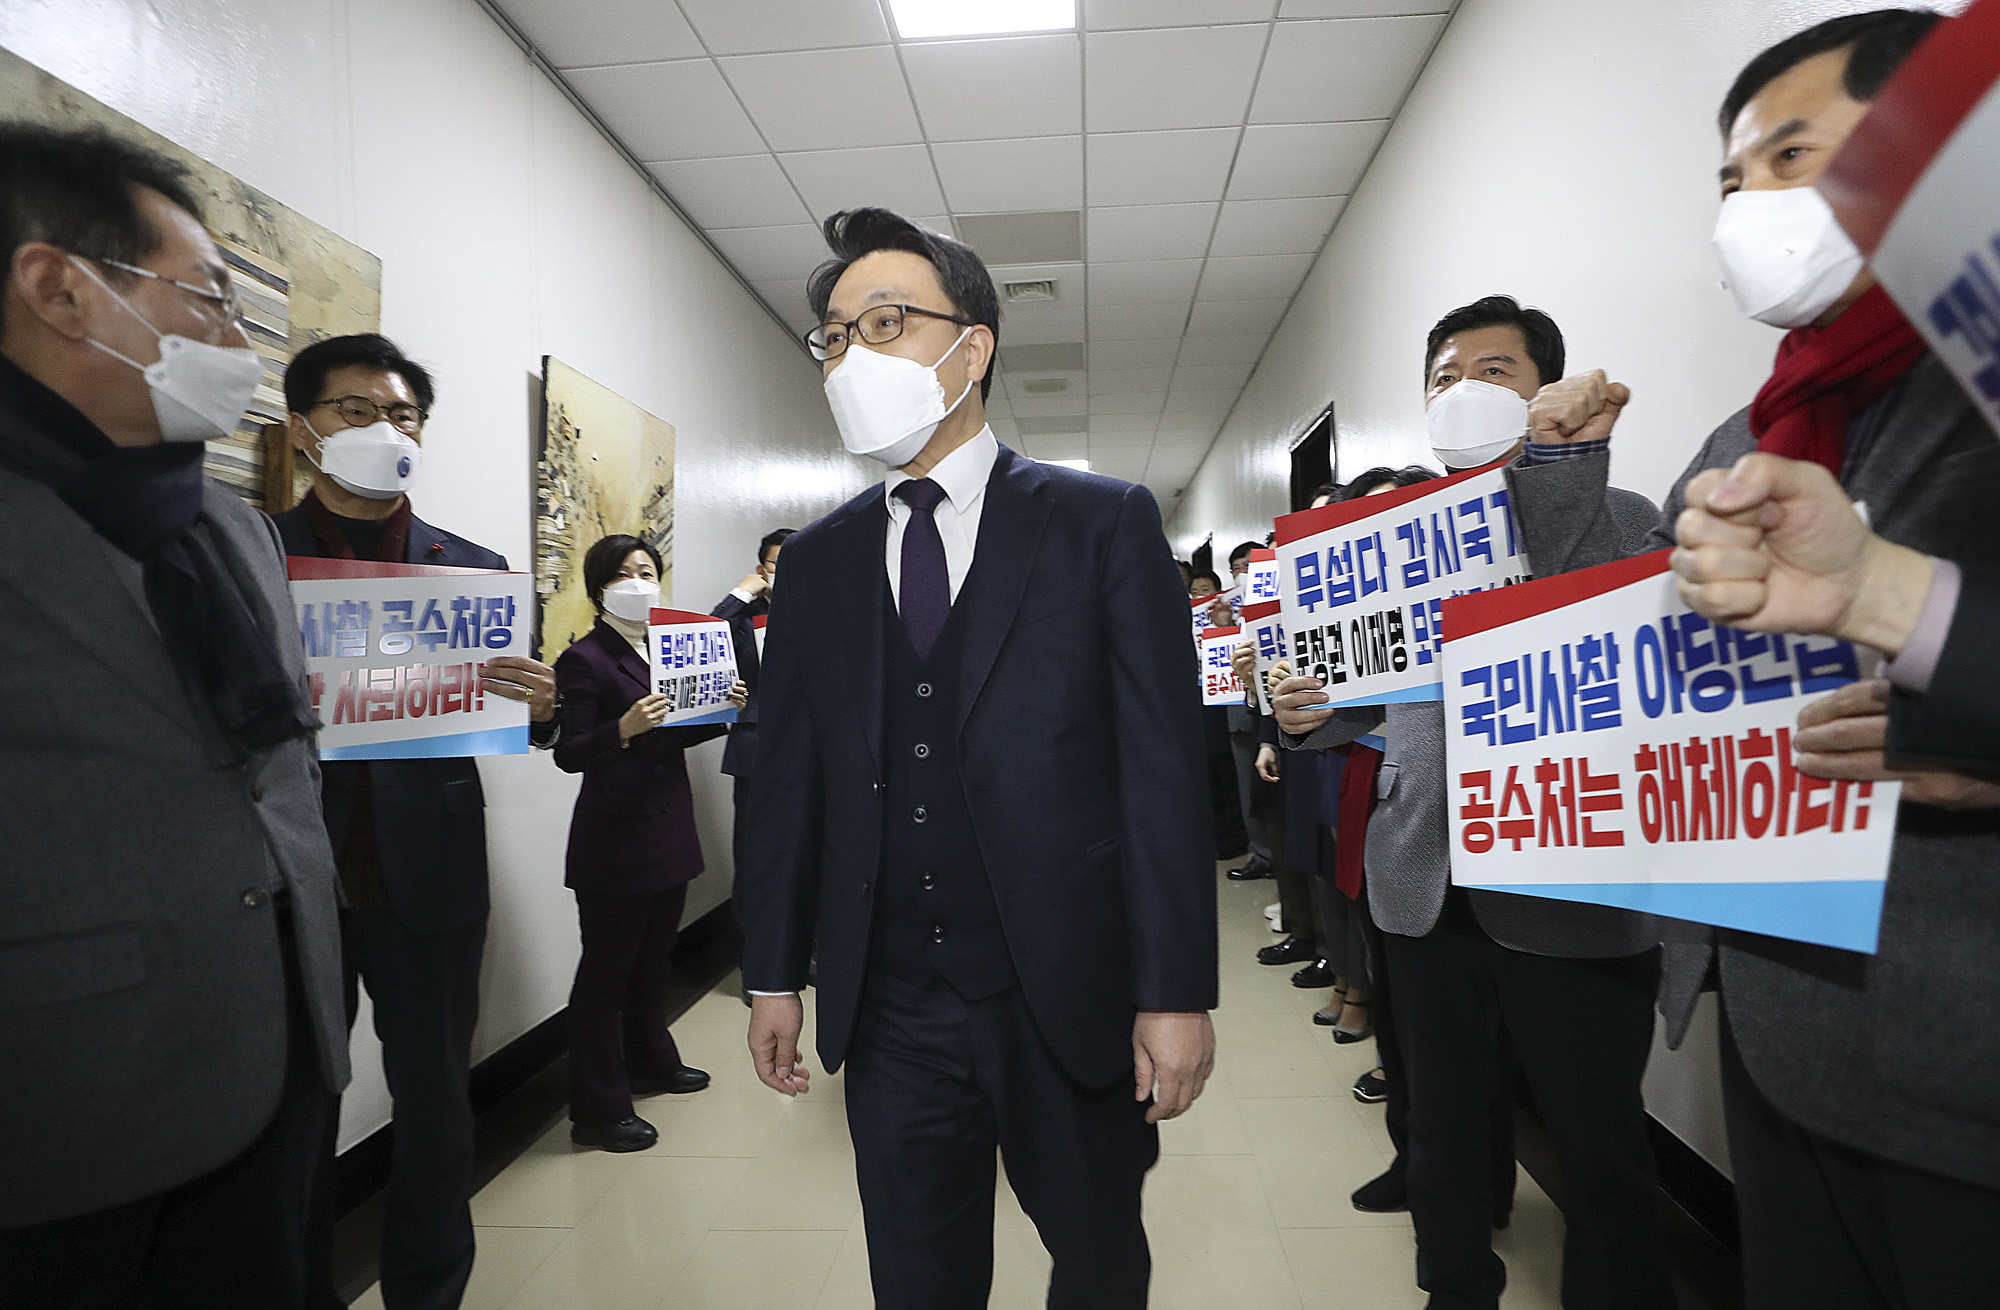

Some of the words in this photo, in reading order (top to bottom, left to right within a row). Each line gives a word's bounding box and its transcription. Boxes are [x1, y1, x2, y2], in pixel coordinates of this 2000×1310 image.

[1294, 531, 1387, 613] 무섭다
[378, 596, 516, 656] 공수처장
[660, 633, 696, 670] 무섭다
[1350, 606, 1407, 678] 이재명
[332, 662, 486, 725] 사퇴하라!
[1460, 631, 1623, 746] 국민사찰
[1459, 757, 1625, 853] 공수처는
